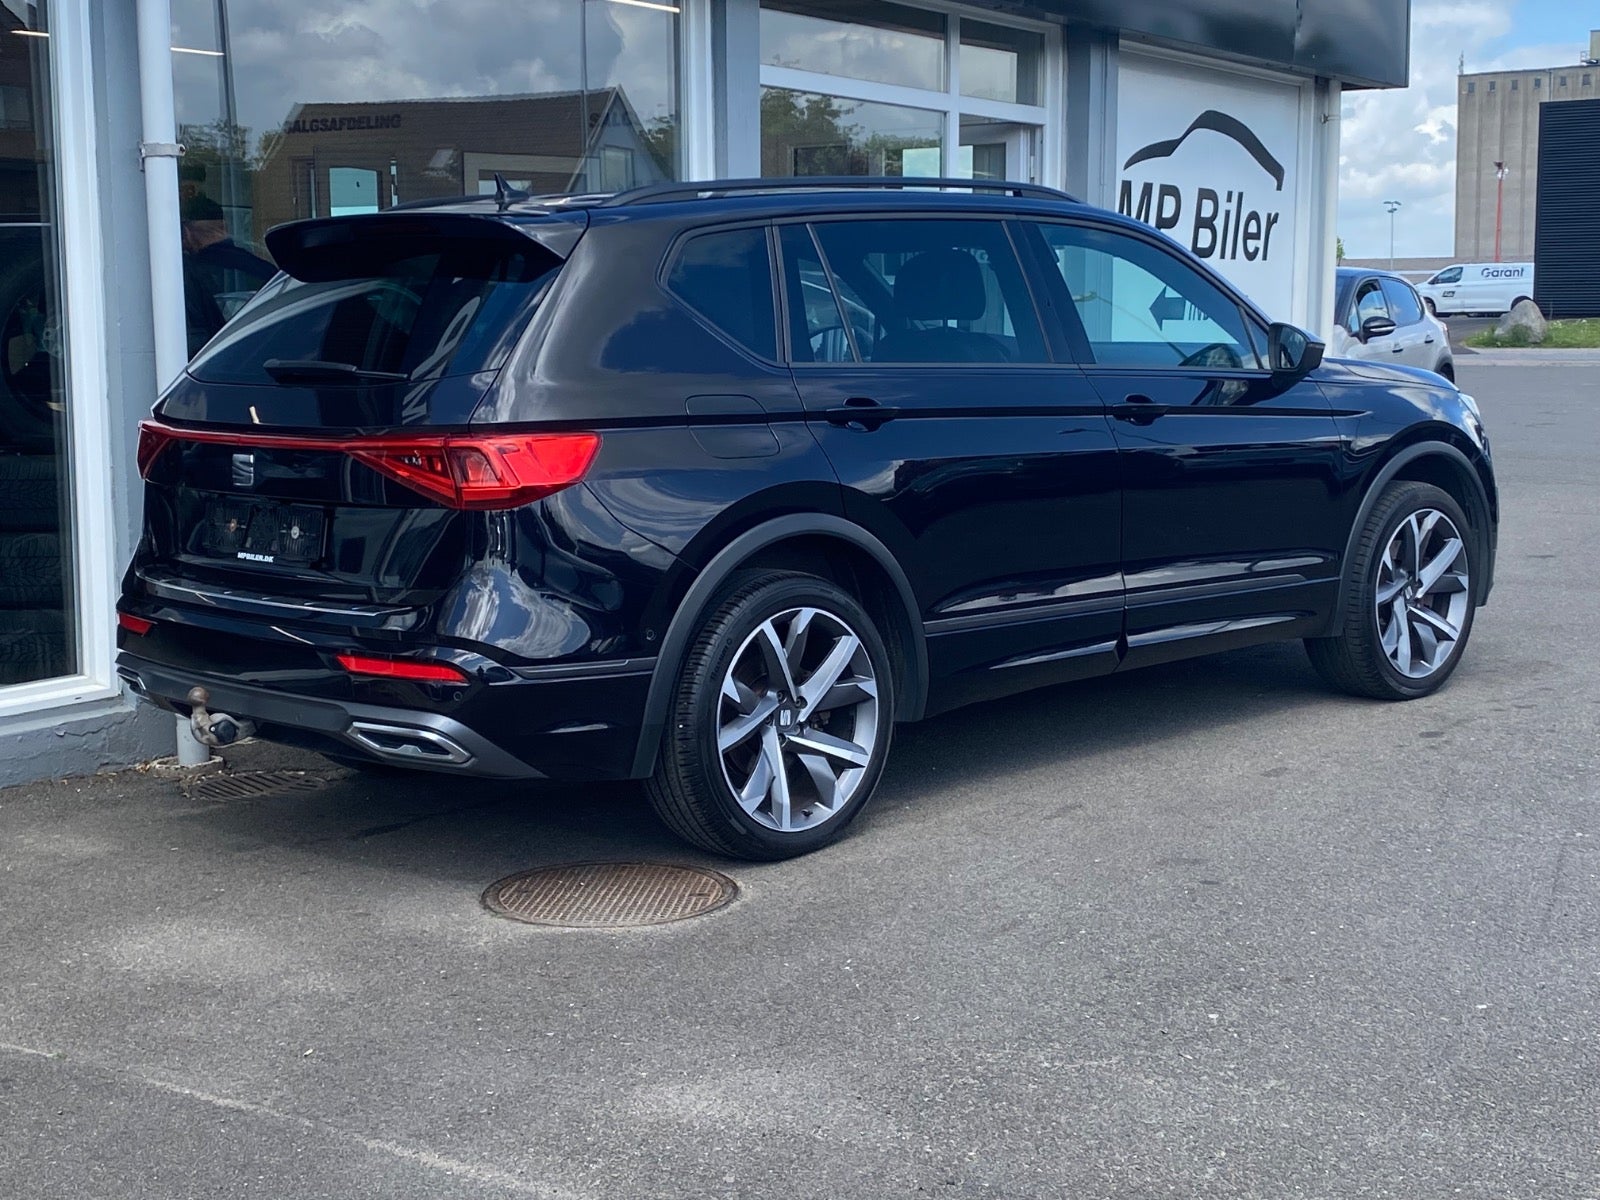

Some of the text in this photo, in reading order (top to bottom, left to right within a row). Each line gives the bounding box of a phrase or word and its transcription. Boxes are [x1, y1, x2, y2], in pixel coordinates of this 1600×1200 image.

[1118, 180, 1279, 262] MP Biler
[1481, 267, 1524, 278] Garant
